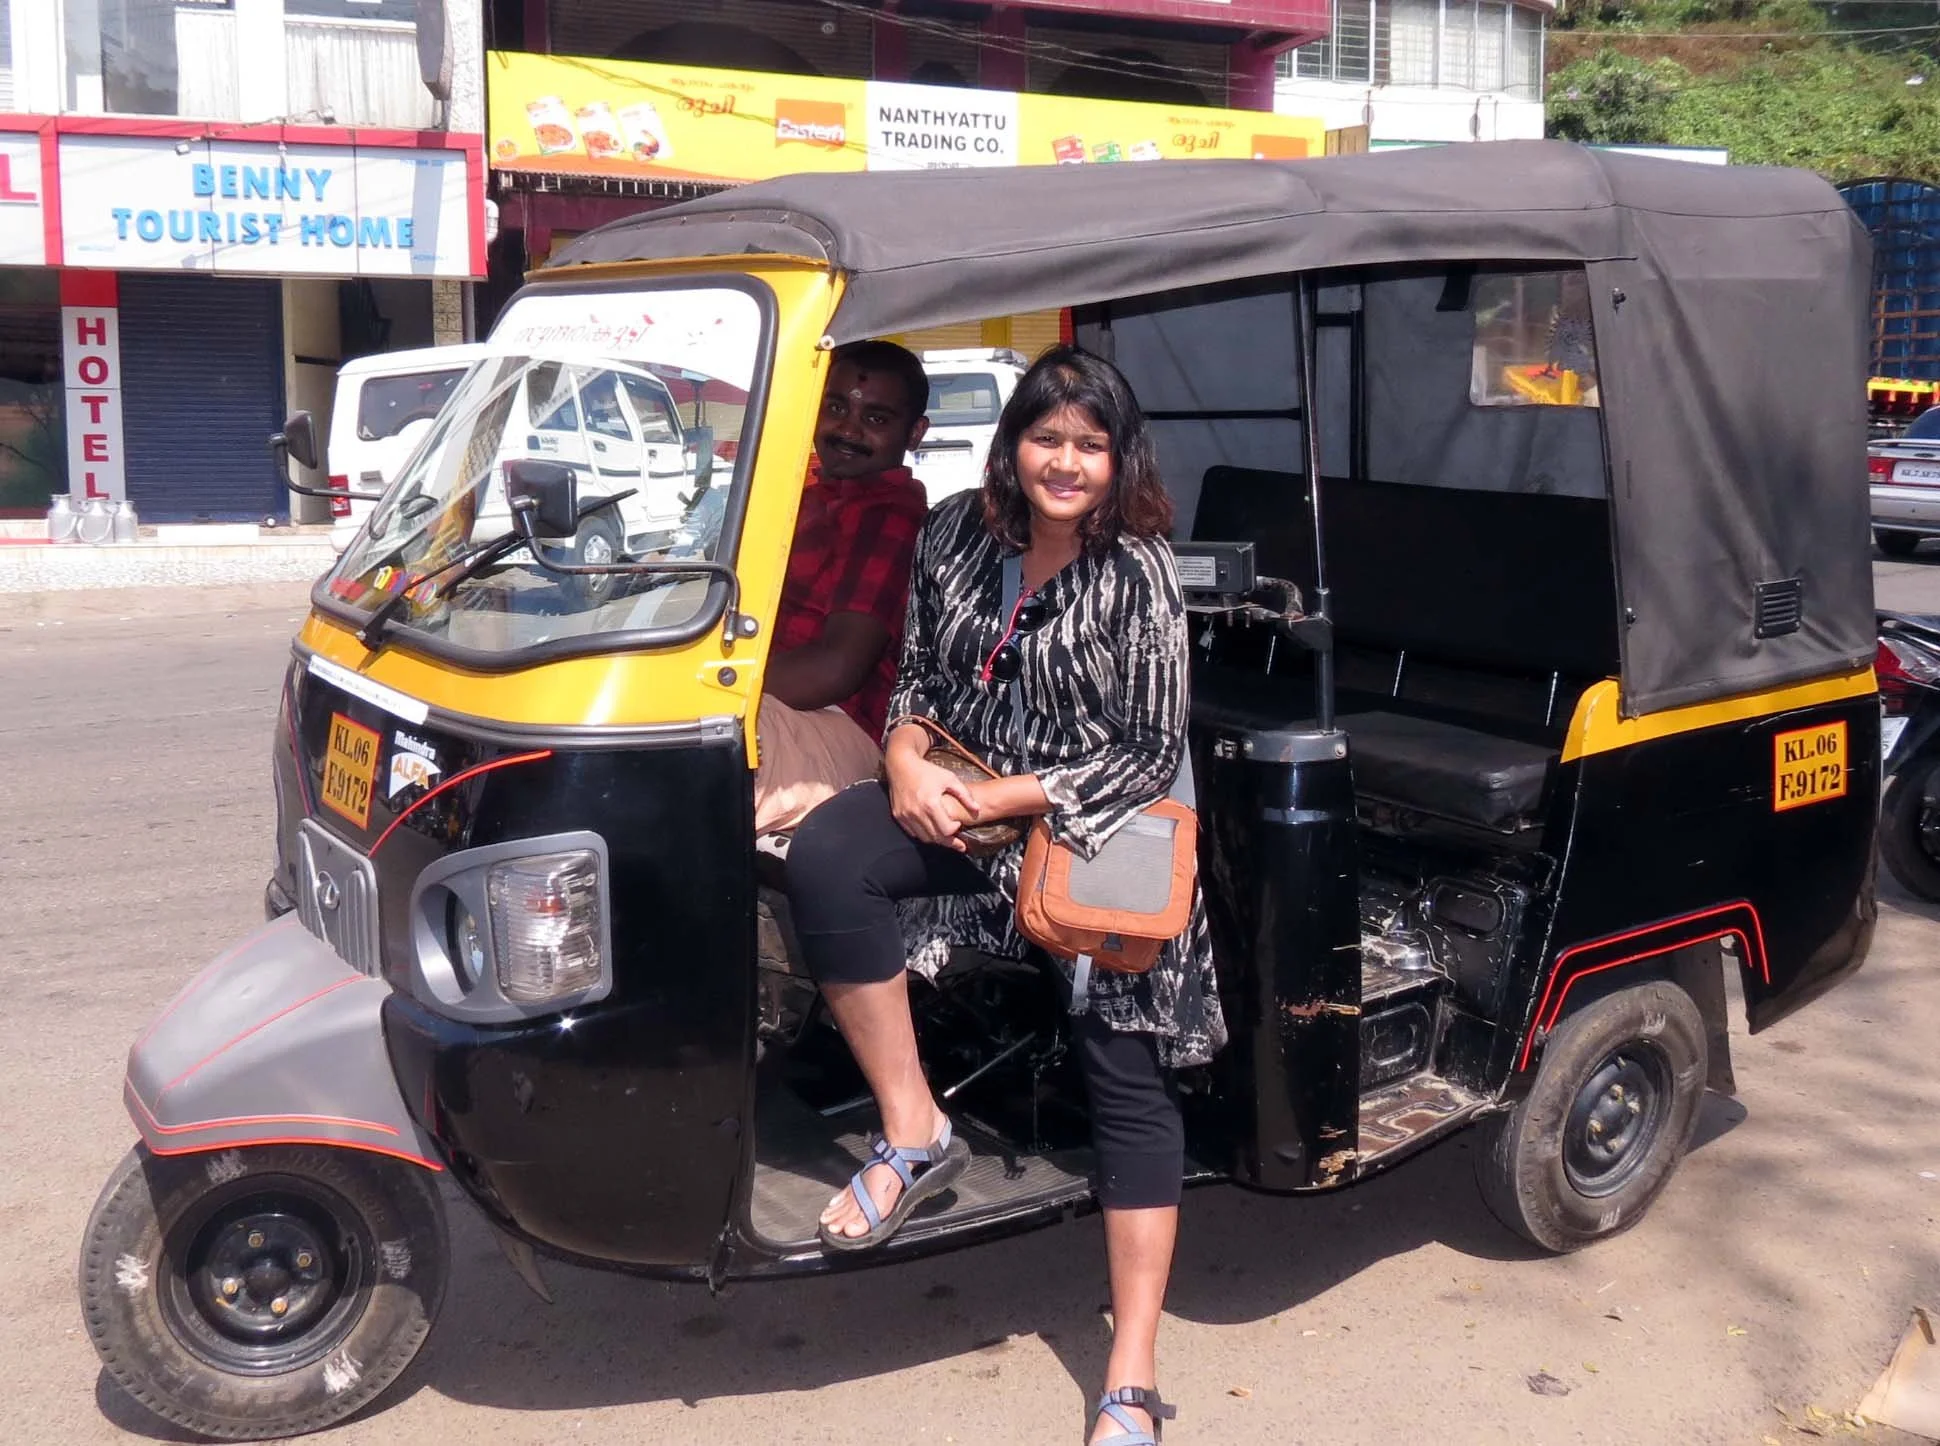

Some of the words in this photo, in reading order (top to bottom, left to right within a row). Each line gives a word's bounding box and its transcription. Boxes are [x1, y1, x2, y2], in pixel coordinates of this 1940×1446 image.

[879, 106, 1006, 131] NANTHYATTU
[881, 131, 967, 152] TRADING
[974, 137, 1004, 154] CO.
[191, 163, 332, 202] BENNY
[112, 207, 282, 245] TOURIST
[301, 214, 414, 249] HOME
[76, 317, 110, 500] HOTEL
[1784, 732, 1837, 763] KL.06
[393, 755, 430, 790] ALFA
[1780, 763, 1840, 802] F.9172
